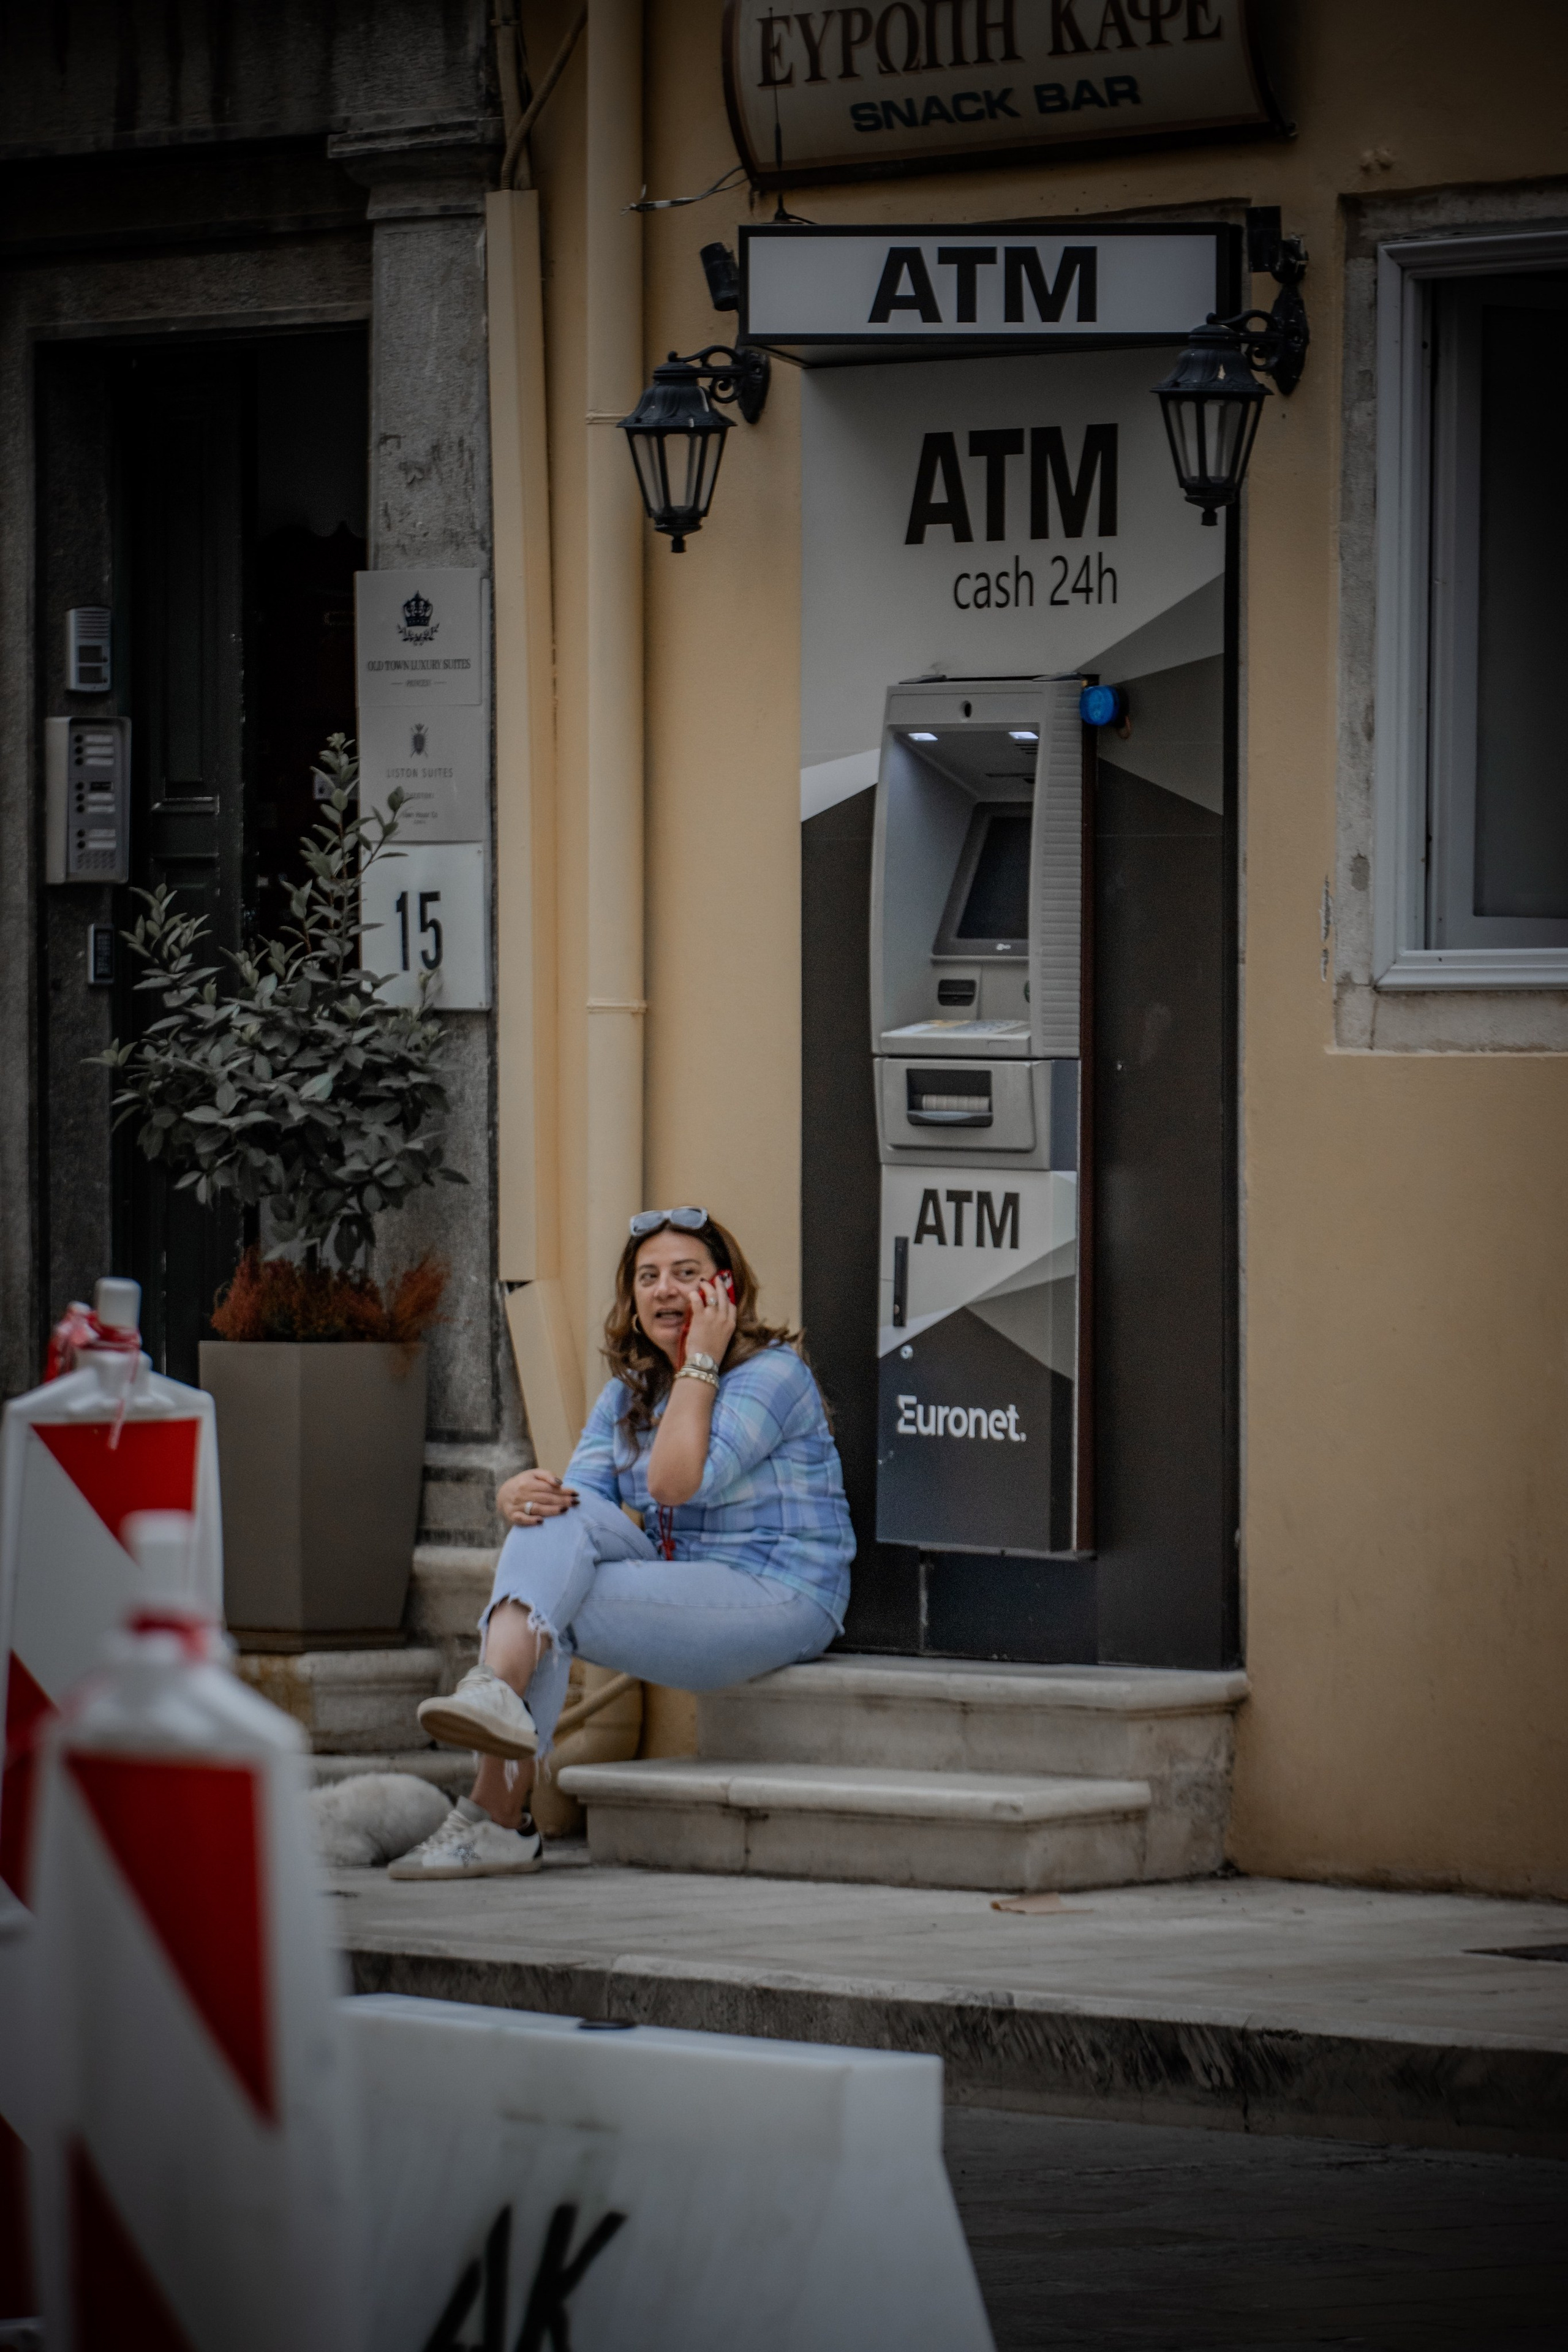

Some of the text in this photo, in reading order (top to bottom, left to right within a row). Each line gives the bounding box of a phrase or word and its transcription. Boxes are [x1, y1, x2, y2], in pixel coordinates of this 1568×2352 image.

[756, 0, 1022, 87] ΕΥΡΩΠΗ
[850, 75, 1143, 133] SNACK BAR
[868, 246, 1098, 323] ATM
[905, 423, 1118, 545] ATM
[953, 551, 1117, 609] cash 24h
[368, 658, 471, 671] OLD TOWN LUXURY SUITES
[387, 767, 454, 778] LISTON SUITES
[396, 891, 443, 971] 15
[913, 1188, 1020, 1249] ATM
